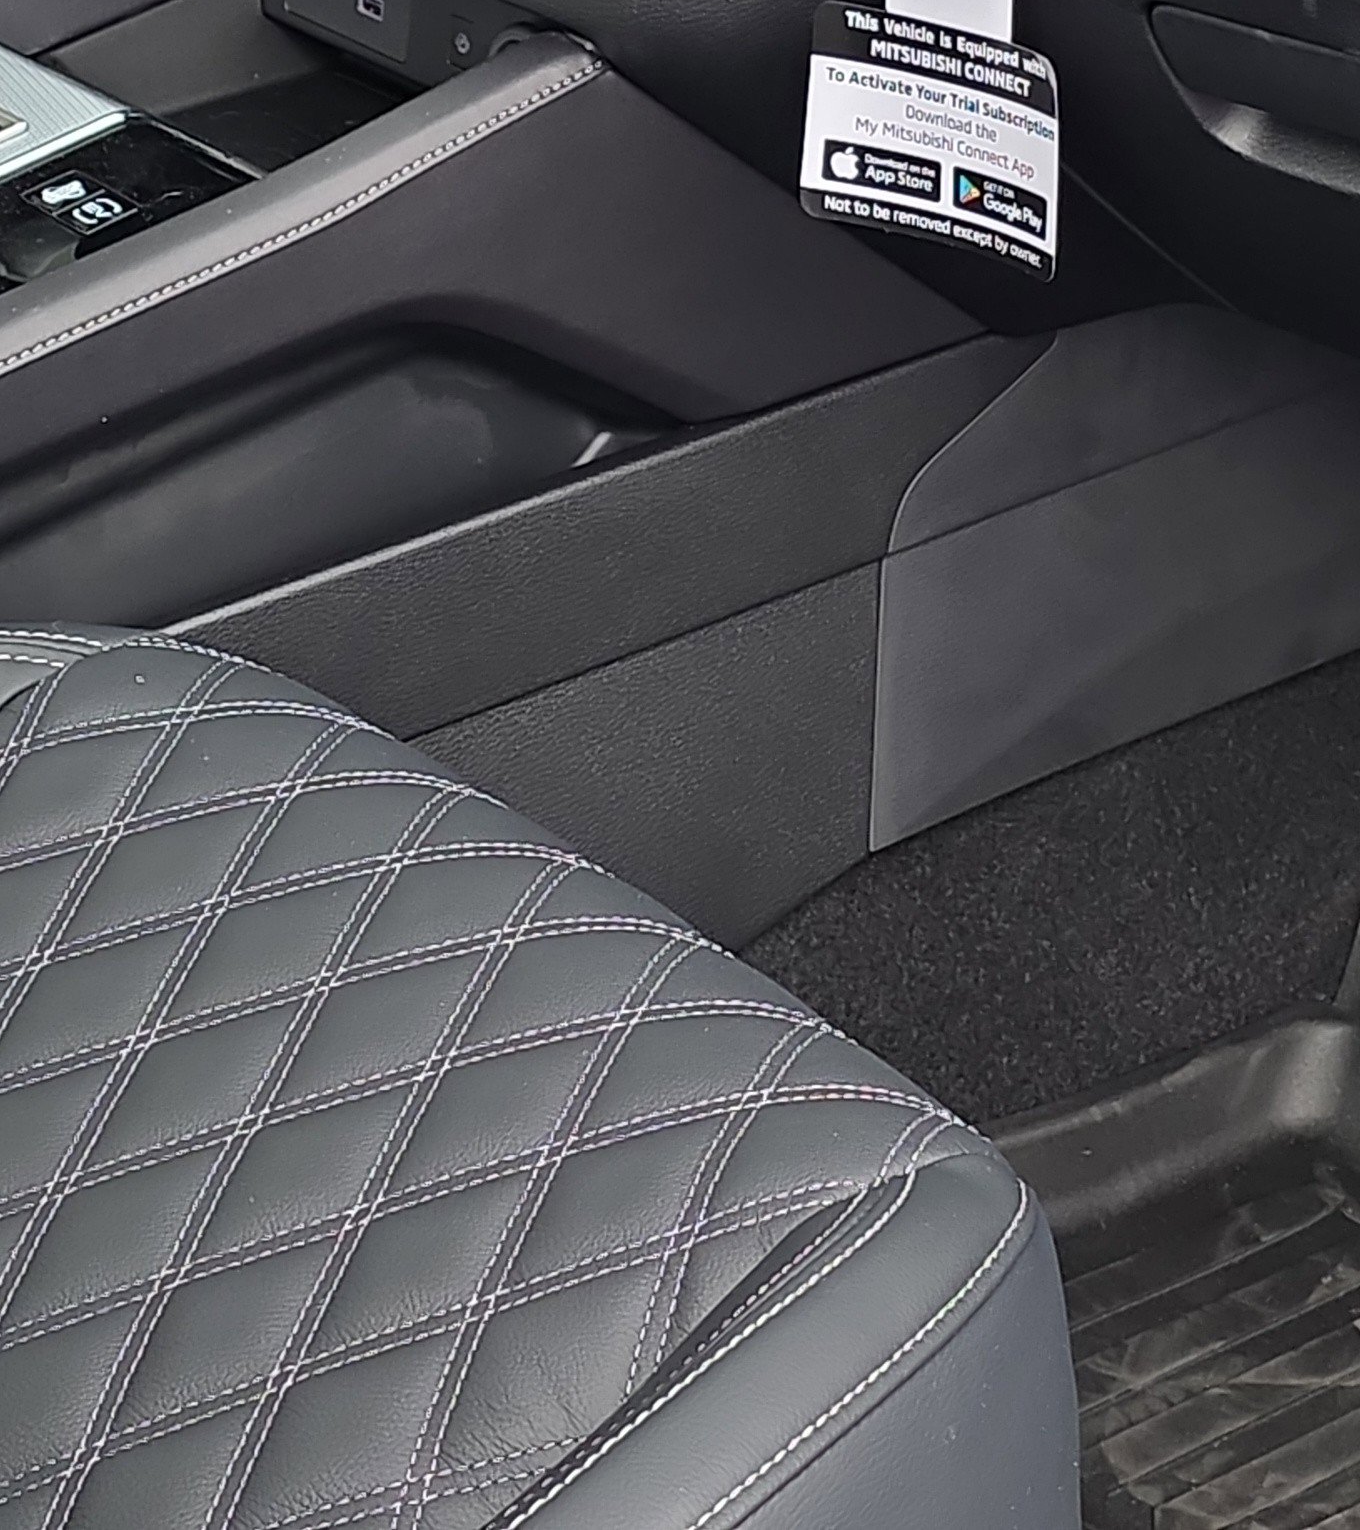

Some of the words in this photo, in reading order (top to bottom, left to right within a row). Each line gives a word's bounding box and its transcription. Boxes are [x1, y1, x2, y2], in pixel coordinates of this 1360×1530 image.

[845, 10, 879, 32] This
[883, 18, 935, 45] Vehicle
[940, 30, 952, 49] is
[956, 36, 1019, 69] Equipped
[870, 39, 962, 77] MITSUBISHI
[964, 62, 1031, 97] CONNECT
[826, 67, 845, 82] To
[848, 71, 912, 96] Activate
[915, 83, 946, 104] Your
[949, 92, 979, 114] Trial
[982, 102, 1055, 141] Subscription
[905, 104, 972, 135] Download
[976, 123, 997, 142] the
[855, 117, 878, 137] My
[882, 122, 953, 151] Mitsubishi
[957, 140, 1009, 170] Connect
[1012, 158, 1035, 179] App
[864, 165, 895, 185] App
[897, 171, 933, 192] Store
[824, 195, 852, 214] Not
[853, 200, 871, 217] to
[872, 203, 891, 221] be
[893, 210, 951, 235] removed
[953, 225, 993, 248] except
[994, 235, 1009, 256] by
[983, 193, 1022, 222] Google
[1023, 206, 1043, 233] Play
